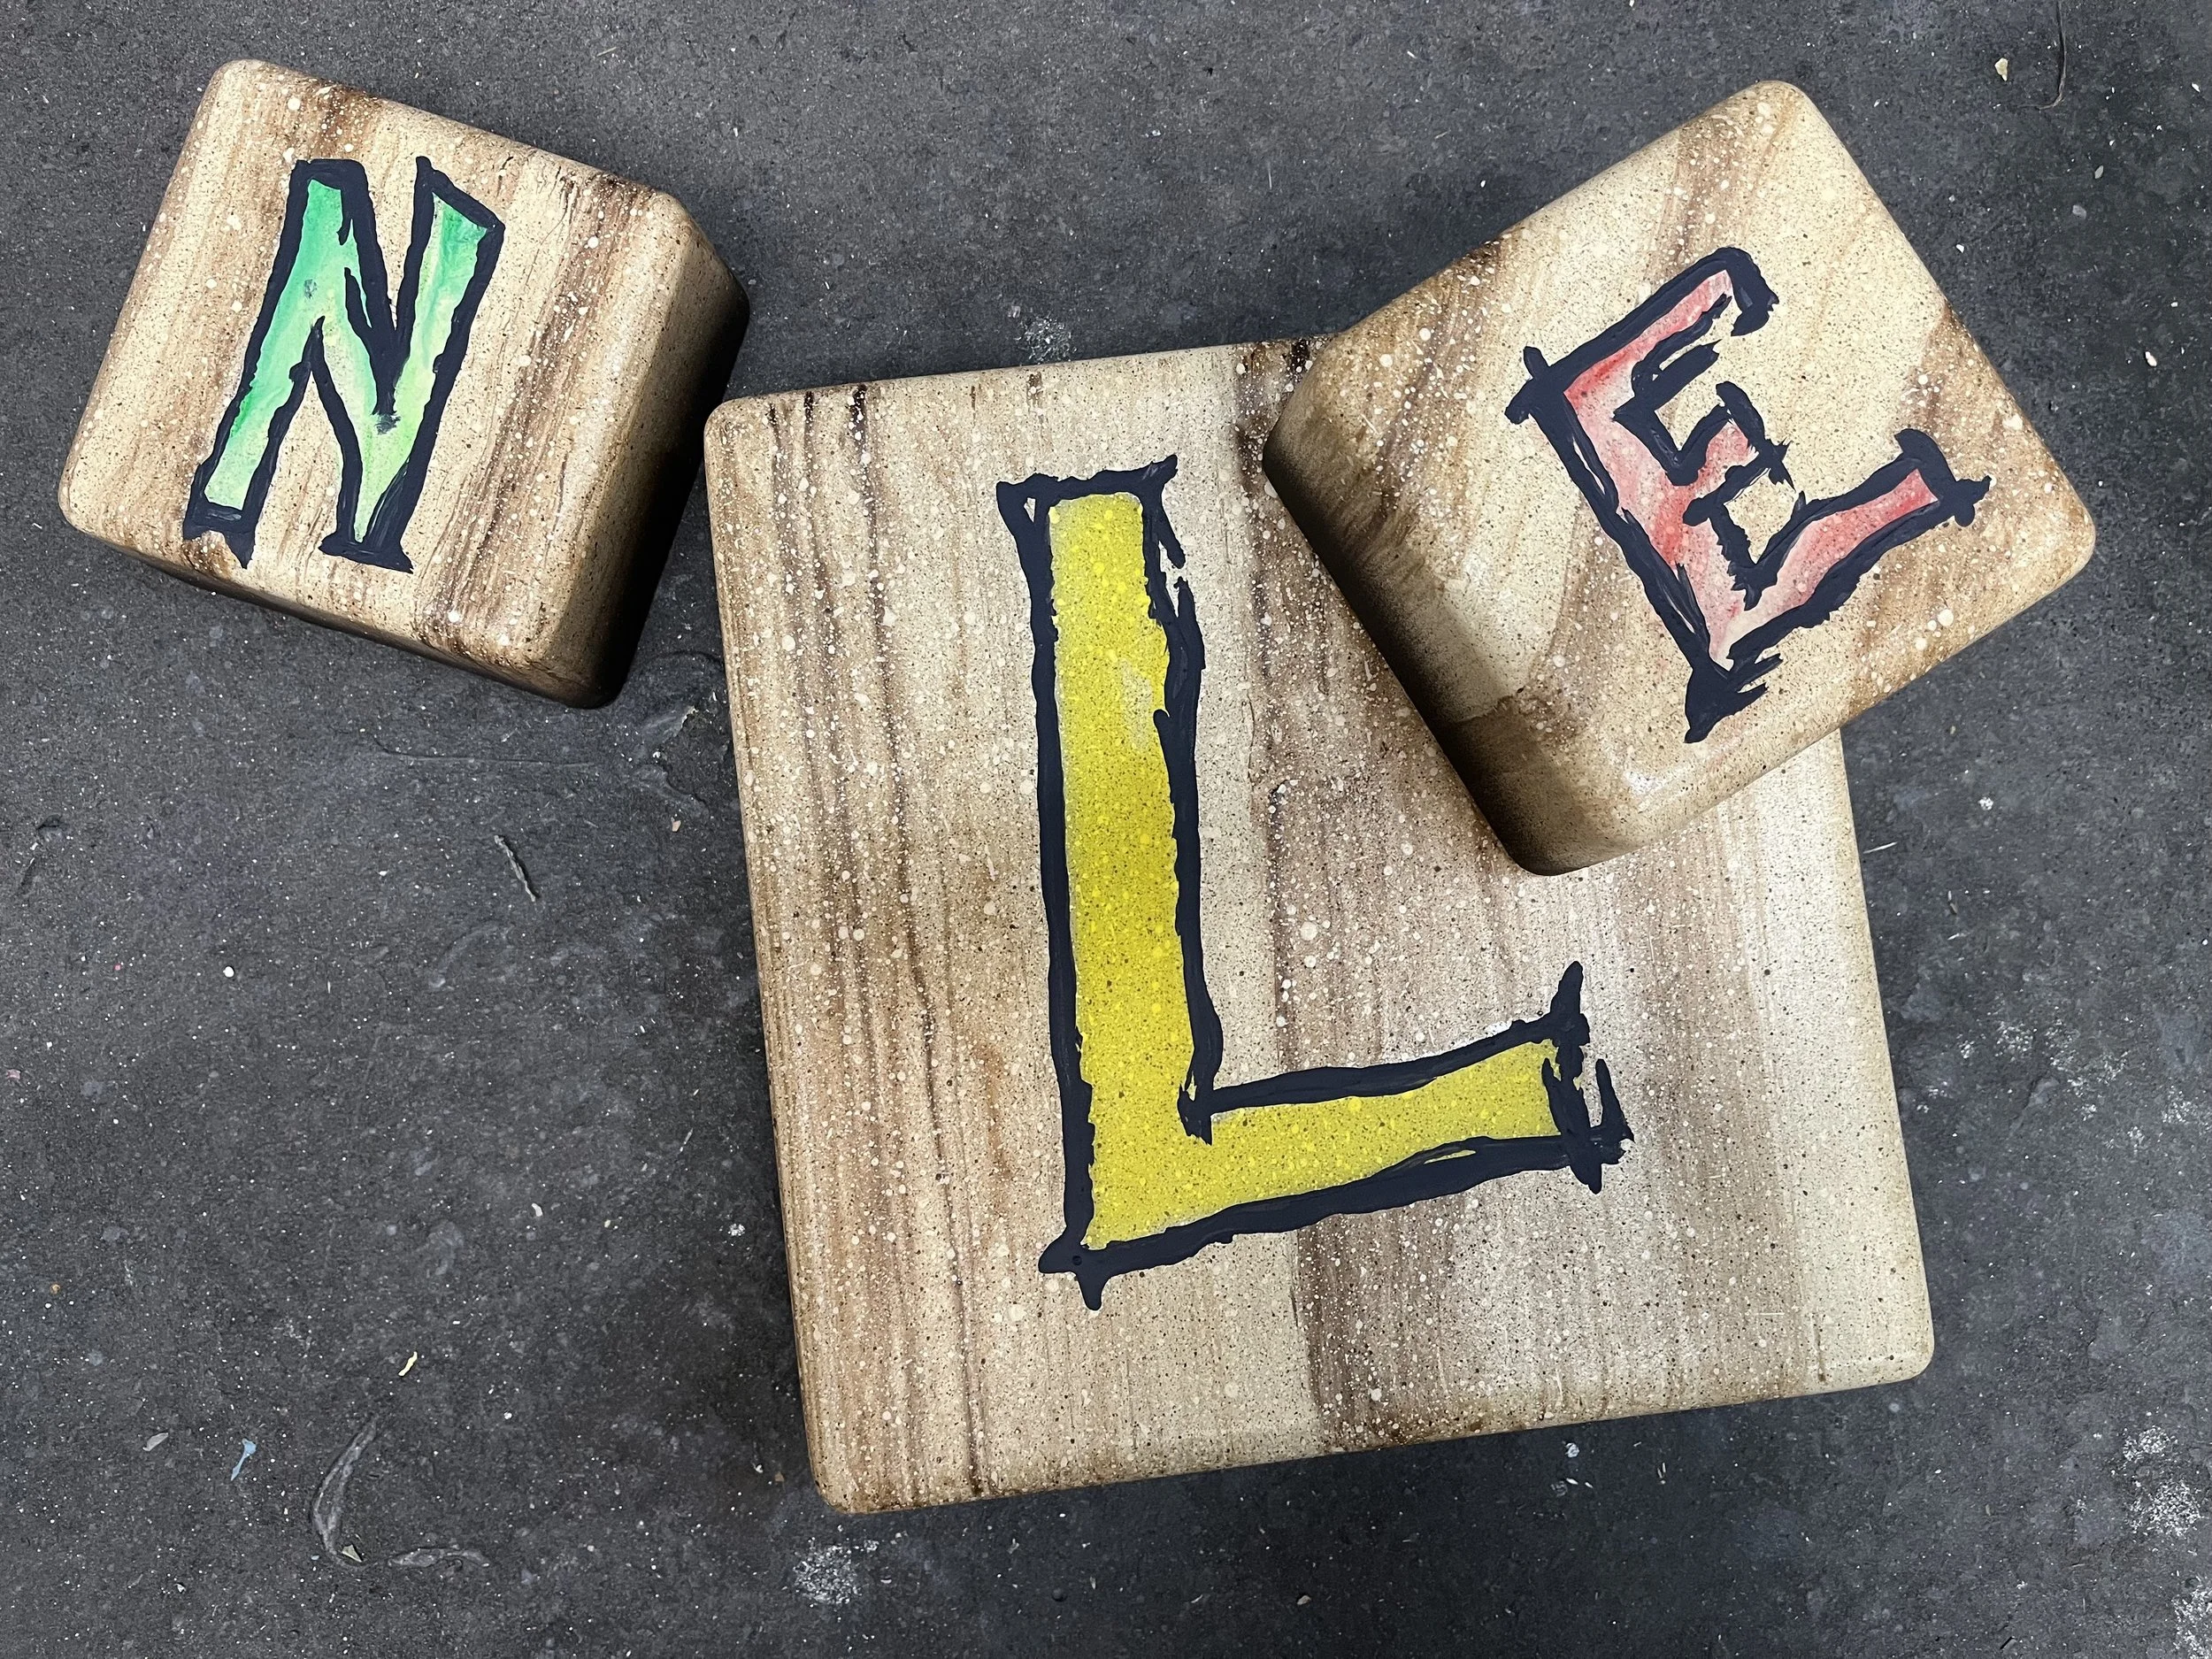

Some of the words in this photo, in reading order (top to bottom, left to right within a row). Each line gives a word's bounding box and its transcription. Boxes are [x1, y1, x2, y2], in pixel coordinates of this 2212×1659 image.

[184, 157, 504, 574] N
[1504, 247, 1993, 743] E
[996, 454, 1635, 1310] L
